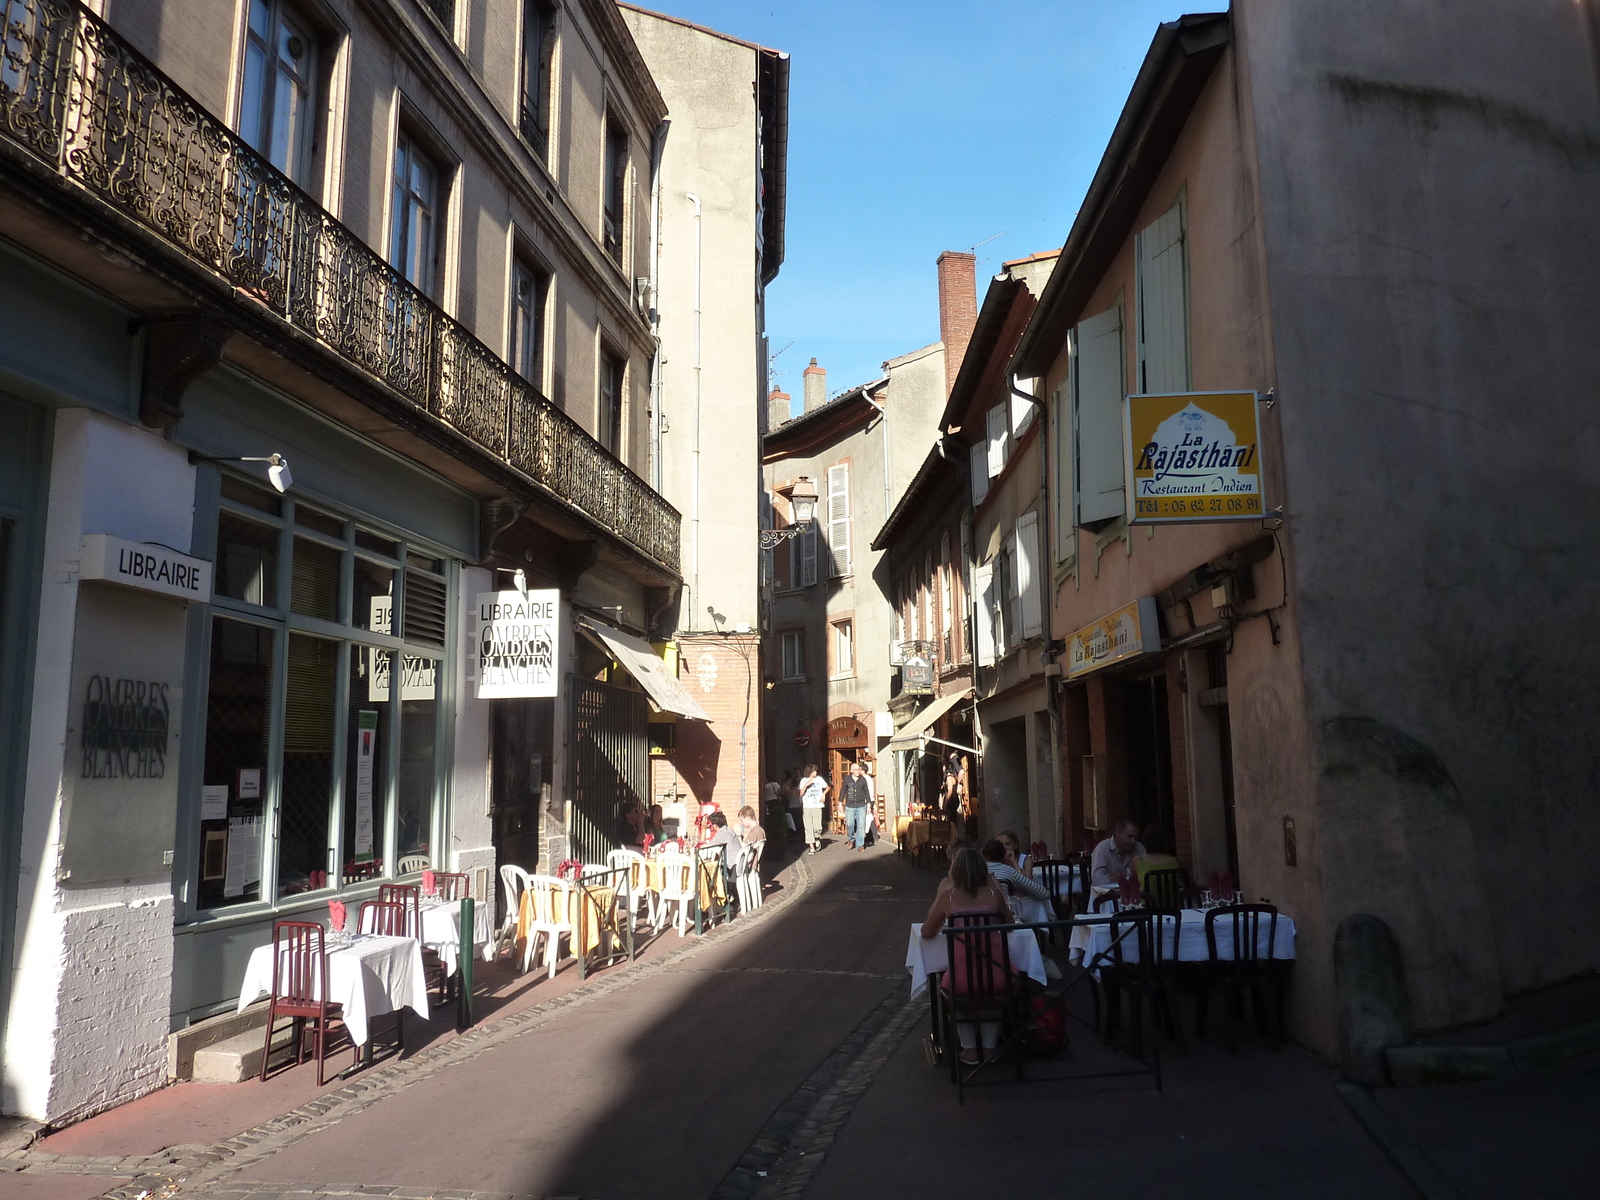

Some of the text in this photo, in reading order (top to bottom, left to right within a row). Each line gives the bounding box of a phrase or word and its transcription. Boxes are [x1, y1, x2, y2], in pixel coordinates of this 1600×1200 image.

[1180, 432, 1203, 447] La
[1142, 476, 1253, 495] Restaurant Indien
[1136, 500, 1159, 513] Tél
[1171, 500, 1186, 513] 05
[1190, 500, 1205, 512] 62
[1209, 499, 1222, 512] 27
[1227, 499, 1242, 511] 08
[1246, 498, 1260, 511] 91
[119, 548, 200, 591] LIBRAIRIE
[480, 602, 553, 621] LIBRAIRIE
[480, 623, 553, 657] OMBRES
[1075, 650, 1083, 663] La
[479, 655, 553, 685] BLANCHES
[84, 674, 170, 734] OMBRES
[80, 729, 167, 779] BLANCHES
[243, 815, 251, 825] LE
